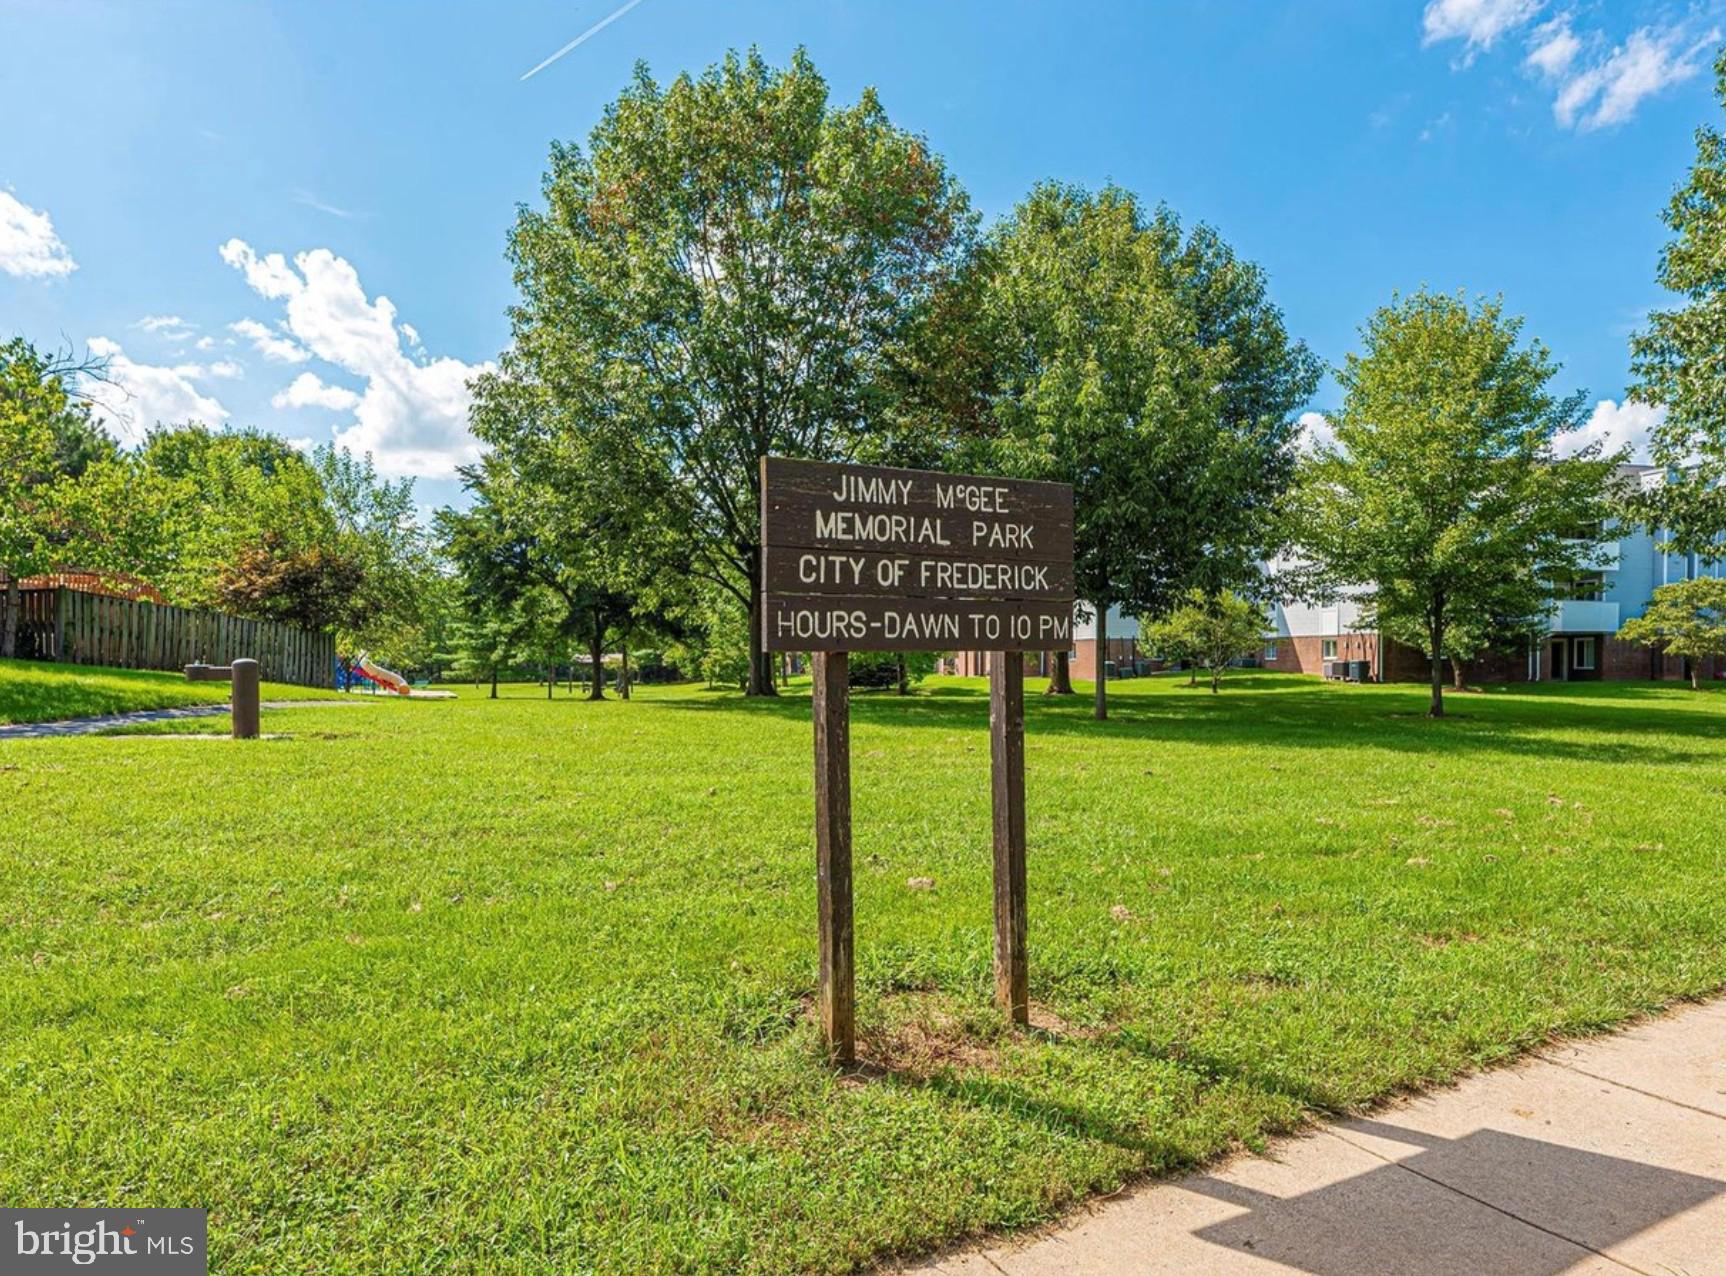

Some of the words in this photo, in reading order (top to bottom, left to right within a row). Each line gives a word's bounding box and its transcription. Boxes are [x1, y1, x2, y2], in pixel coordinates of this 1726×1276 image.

[833, 474, 913, 505] JIMMY
[936, 483, 1010, 513] McGEE
[815, 509, 951, 546] MEMORIAL
[972, 521, 1034, 549] PARK
[799, 554, 865, 584] CITY
[876, 559, 909, 587] OF
[920, 561, 1049, 590] FREDERICK
[968, 614, 999, 639] TO
[1010, 615, 1031, 640] 10
[1039, 615, 1069, 640] PM
